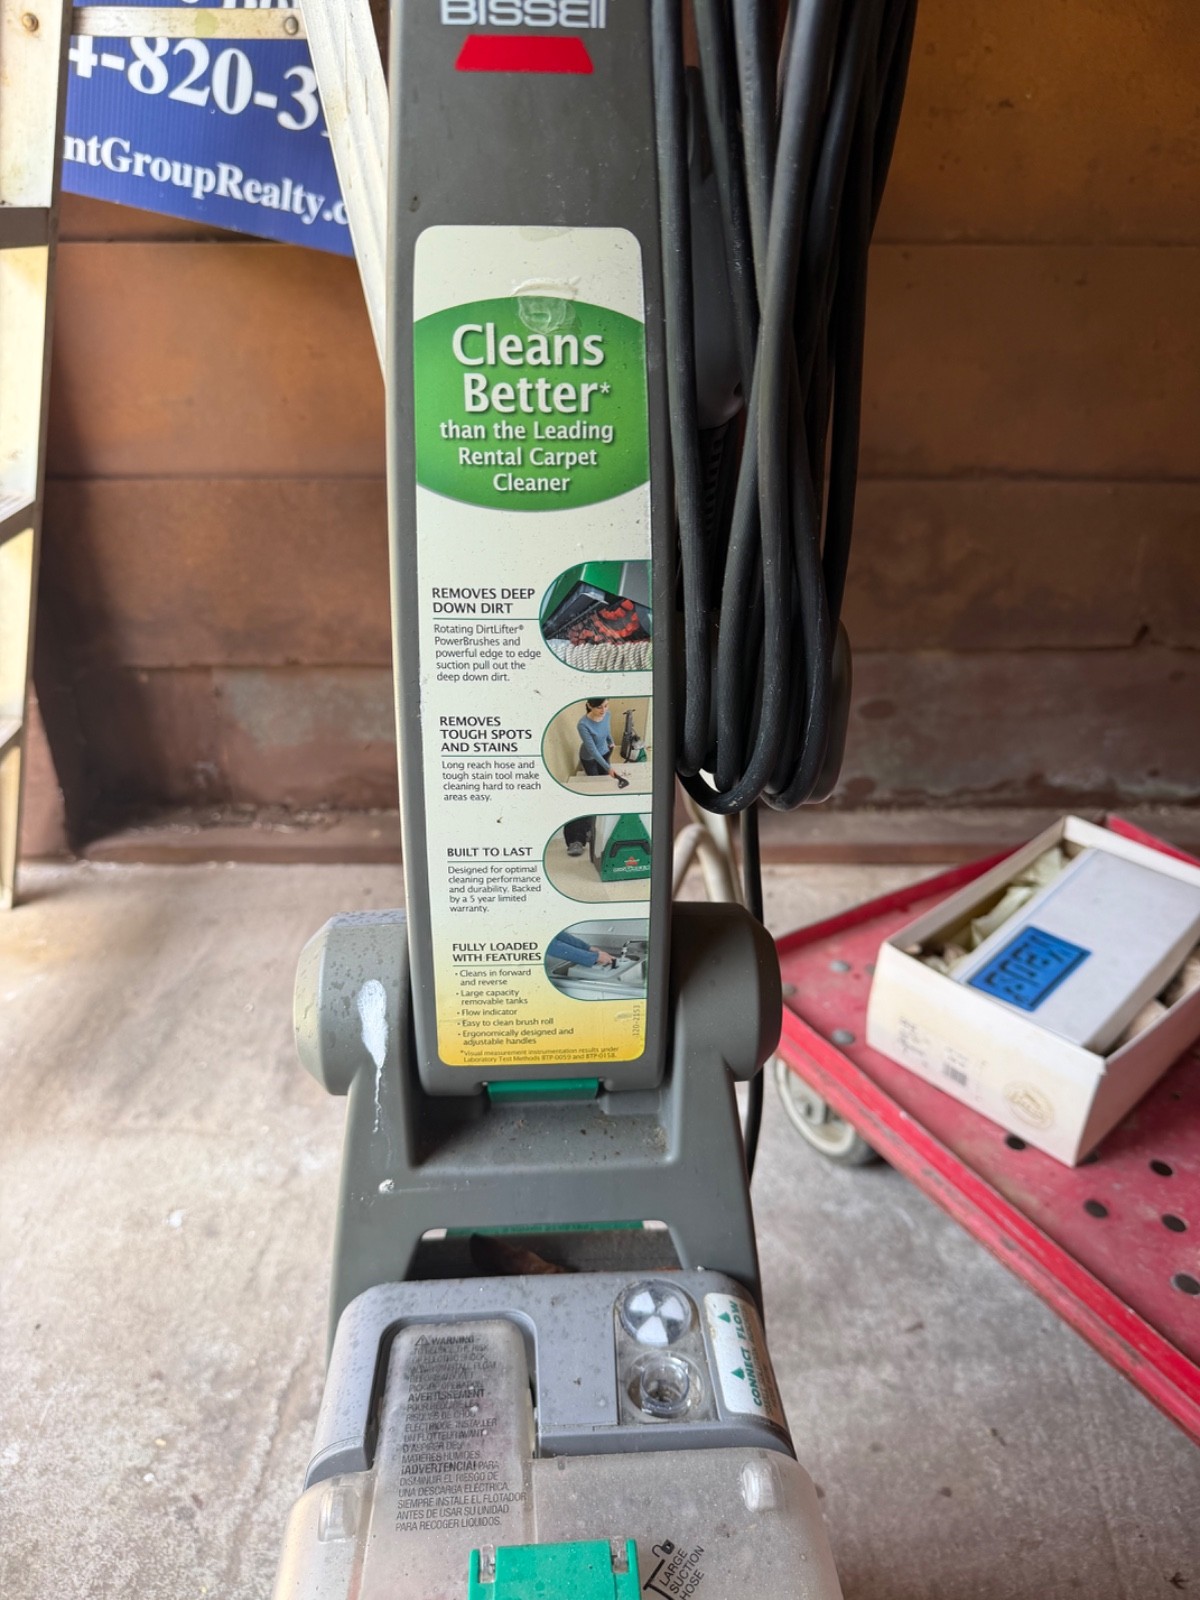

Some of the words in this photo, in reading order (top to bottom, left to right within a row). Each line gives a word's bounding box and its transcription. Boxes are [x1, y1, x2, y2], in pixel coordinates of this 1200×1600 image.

[69, 35, 329, 137] 4-820-3
[452, 322, 605, 366] Cleans
[439, 419, 485, 439] than
[492, 420, 526, 439] the
[533, 421, 613, 442] Leading
[458, 447, 522, 465] Rental
[529, 448, 597, 469] Carpet
[493, 473, 570, 491] Cleaner
[432, 587, 497, 599] REMOVES
[501, 588, 535, 599] DEEP
[433, 602, 476, 613] DOWN
[481, 603, 513, 614] DIRT
[434, 624, 473, 636] Rotating
[434, 636, 500, 646] PowerBrushes
[503, 637, 521, 646] and
[436, 648, 477, 659] powerful
[480, 649, 503, 659] edge
[518, 649, 541, 659] edge
[436, 660, 470, 669] suction
[473, 660, 490, 671] pull
[511, 661, 526, 669] the
[437, 672, 460, 683] deep
[462, 672, 488, 681] down
[491, 672, 510, 681] dirt.
[440, 716, 501, 726] REMOVES
[440, 730, 487, 739] TOUGH
[491, 729, 532, 739] SPOTS
[441, 743, 469, 752] AND
[473, 742, 518, 752] STAINS
[442, 761, 464, 770] Long
[467, 761, 491, 769] reach
[494, 761, 515, 769] hose
[518, 761, 535, 769] and
[442, 771, 469, 782] tough
[472, 772, 493, 780] stain
[495, 771, 513, 780] tool
[515, 771, 539, 779] make
[443, 782, 480, 792] cleaning
[483, 782, 503, 790] hard
[517, 782, 541, 790] reach
[470, 794, 491, 802] easy.
[447, 848, 479, 857] BUILT
[482, 847, 500, 857] TO
[503, 847, 533, 856] LAST
[448, 866, 488, 875] Designed
[505, 865, 537, 874] optimal
[448, 876, 484, 885] cleaning
[486, 875, 541, 884] performance
[449, 885, 465, 893] and
[467, 885, 509, 894] durability.
[511, 884, 541, 892] Backed
[449, 895, 460, 904] by
[477, 896, 496, 904] year
[498, 894, 526, 902] limited
[449, 905, 489, 913] warranty.
[452, 943, 486, 951] FULLY
[490, 942, 538, 950] LOADED
[452, 954, 482, 962] WITH
[486, 953, 542, 961] FEATURES
[461, 990, 484, 998] Large
[462, 1029, 518, 1038] Ergonomically
[521, 1028, 557, 1036] designed
[729, 1300, 746, 1340] FLOW
[740, 1347, 762, 1407] CONNECT
[400, 1475, 441, 1486] DISMINUIR
[444, 1474, 453, 1482] EL
[456, 1472, 485, 1482] RIESGO
[487, 1472, 499, 1480] DE
[399, 1488, 415, 1497] UNA
[418, 1485, 462, 1496] DESCARGA
[398, 1498, 434, 1509] SIEMPRE
[436, 1496, 468, 1506] INSTALE
[471, 1495, 480, 1504] EL
[483, 1492, 527, 1503] FLOTADOR
[397, 1510, 424, 1520] ANTES
[426, 1509, 437, 1518] DE
[440, 1508, 462, 1517] USAR
[464, 1507, 476, 1516] SU
[478, 1505, 510, 1515] UNIDAD
[396, 1522, 417, 1531] PARA
[420, 1519, 459, 1530] RECOGER
[659, 1548, 688, 1587] LARGE
[669, 1545, 705, 1594] SUCTION
[680, 1569, 705, 1600] HOSE
